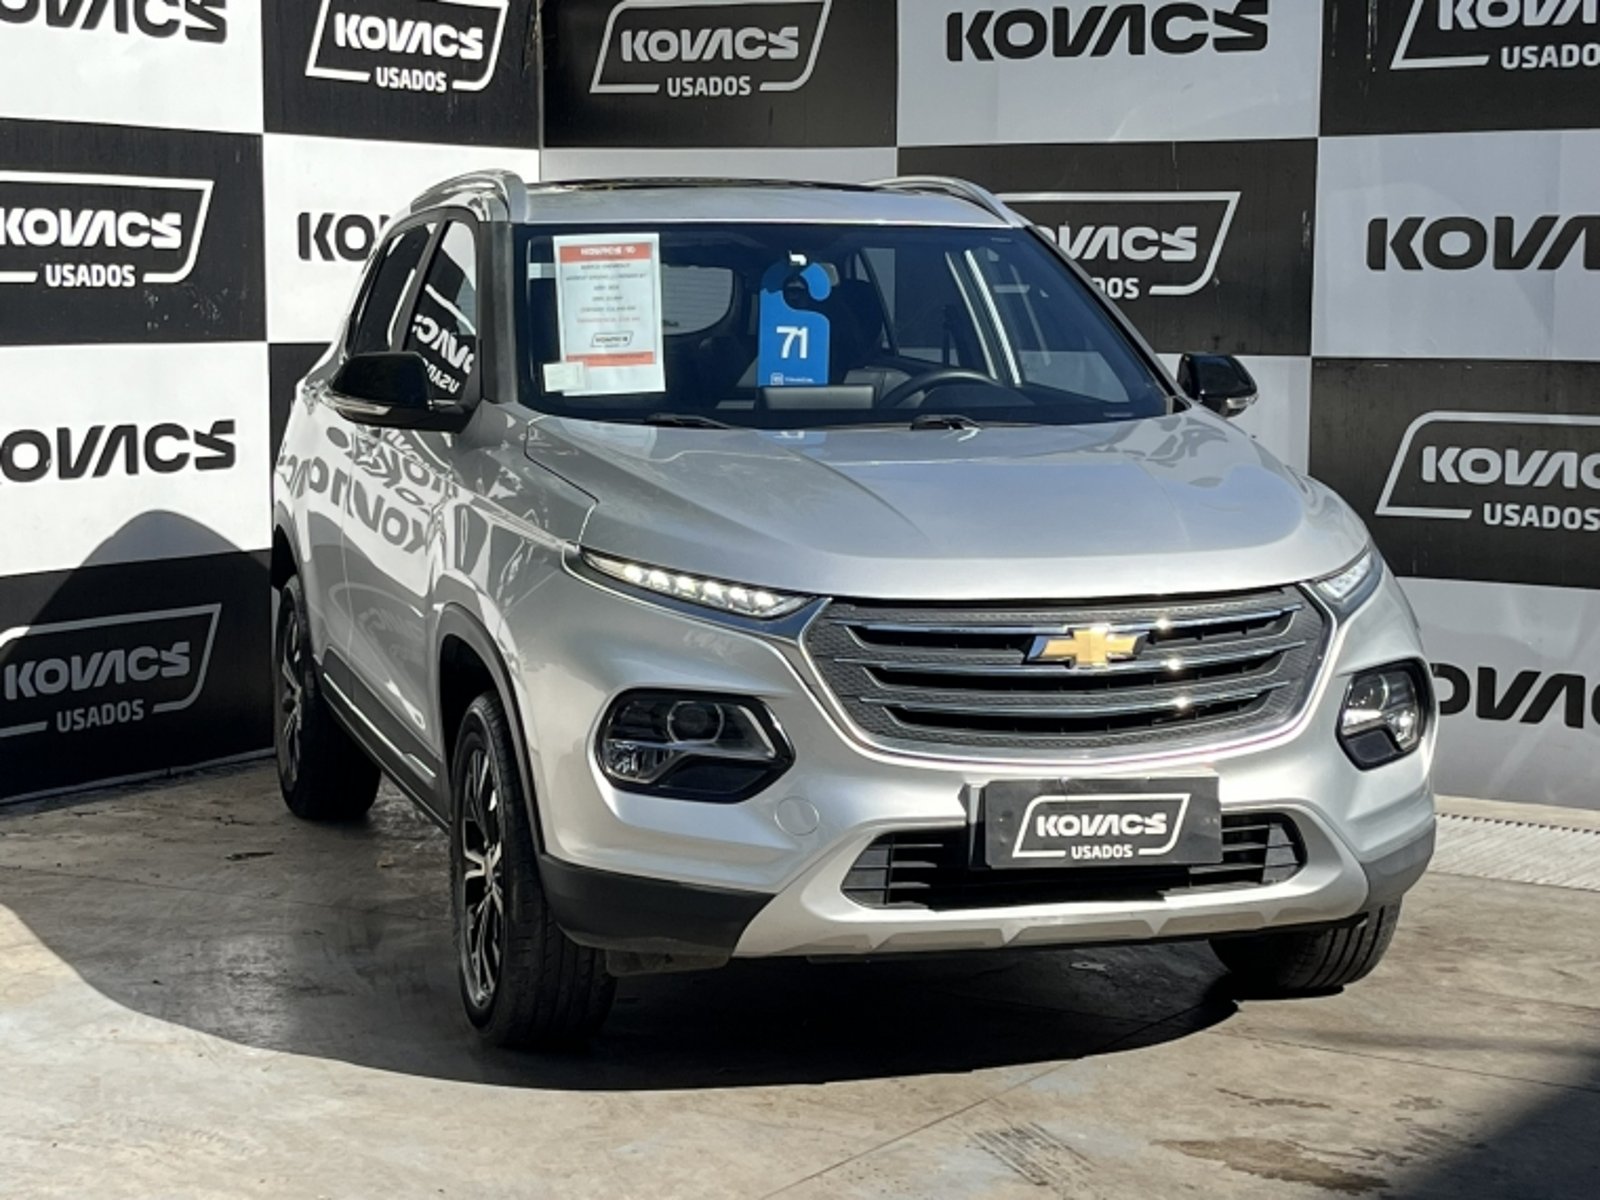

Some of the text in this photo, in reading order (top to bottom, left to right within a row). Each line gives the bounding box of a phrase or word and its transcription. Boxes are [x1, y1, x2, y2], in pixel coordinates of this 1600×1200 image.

[334, 12, 484, 60] KOVACS
[621, 26, 799, 62] KOVACS
[946, 0, 1268, 61] KOVACS
[1500, 43, 1600, 70] USADO
[375, 66, 447, 93] USADOS
[666, 76, 751, 97] USADOS
[0, 207, 182, 249] KOVACS
[298, 212, 390, 262] KO
[1034, 225, 1198, 261] VACS
[1366, 214, 1600, 271] KOVA
[45, 264, 136, 287] USADOS
[776, 326, 807, 359] 71
[0, 419, 236, 483] OVACS
[1483, 503, 1600, 531] USADOS
[5, 641, 190, 700] KOVACS
[56, 699, 144, 734] USADOS
[1036, 812, 1167, 837] KOVACS
[1071, 844, 1133, 859] USADOS
